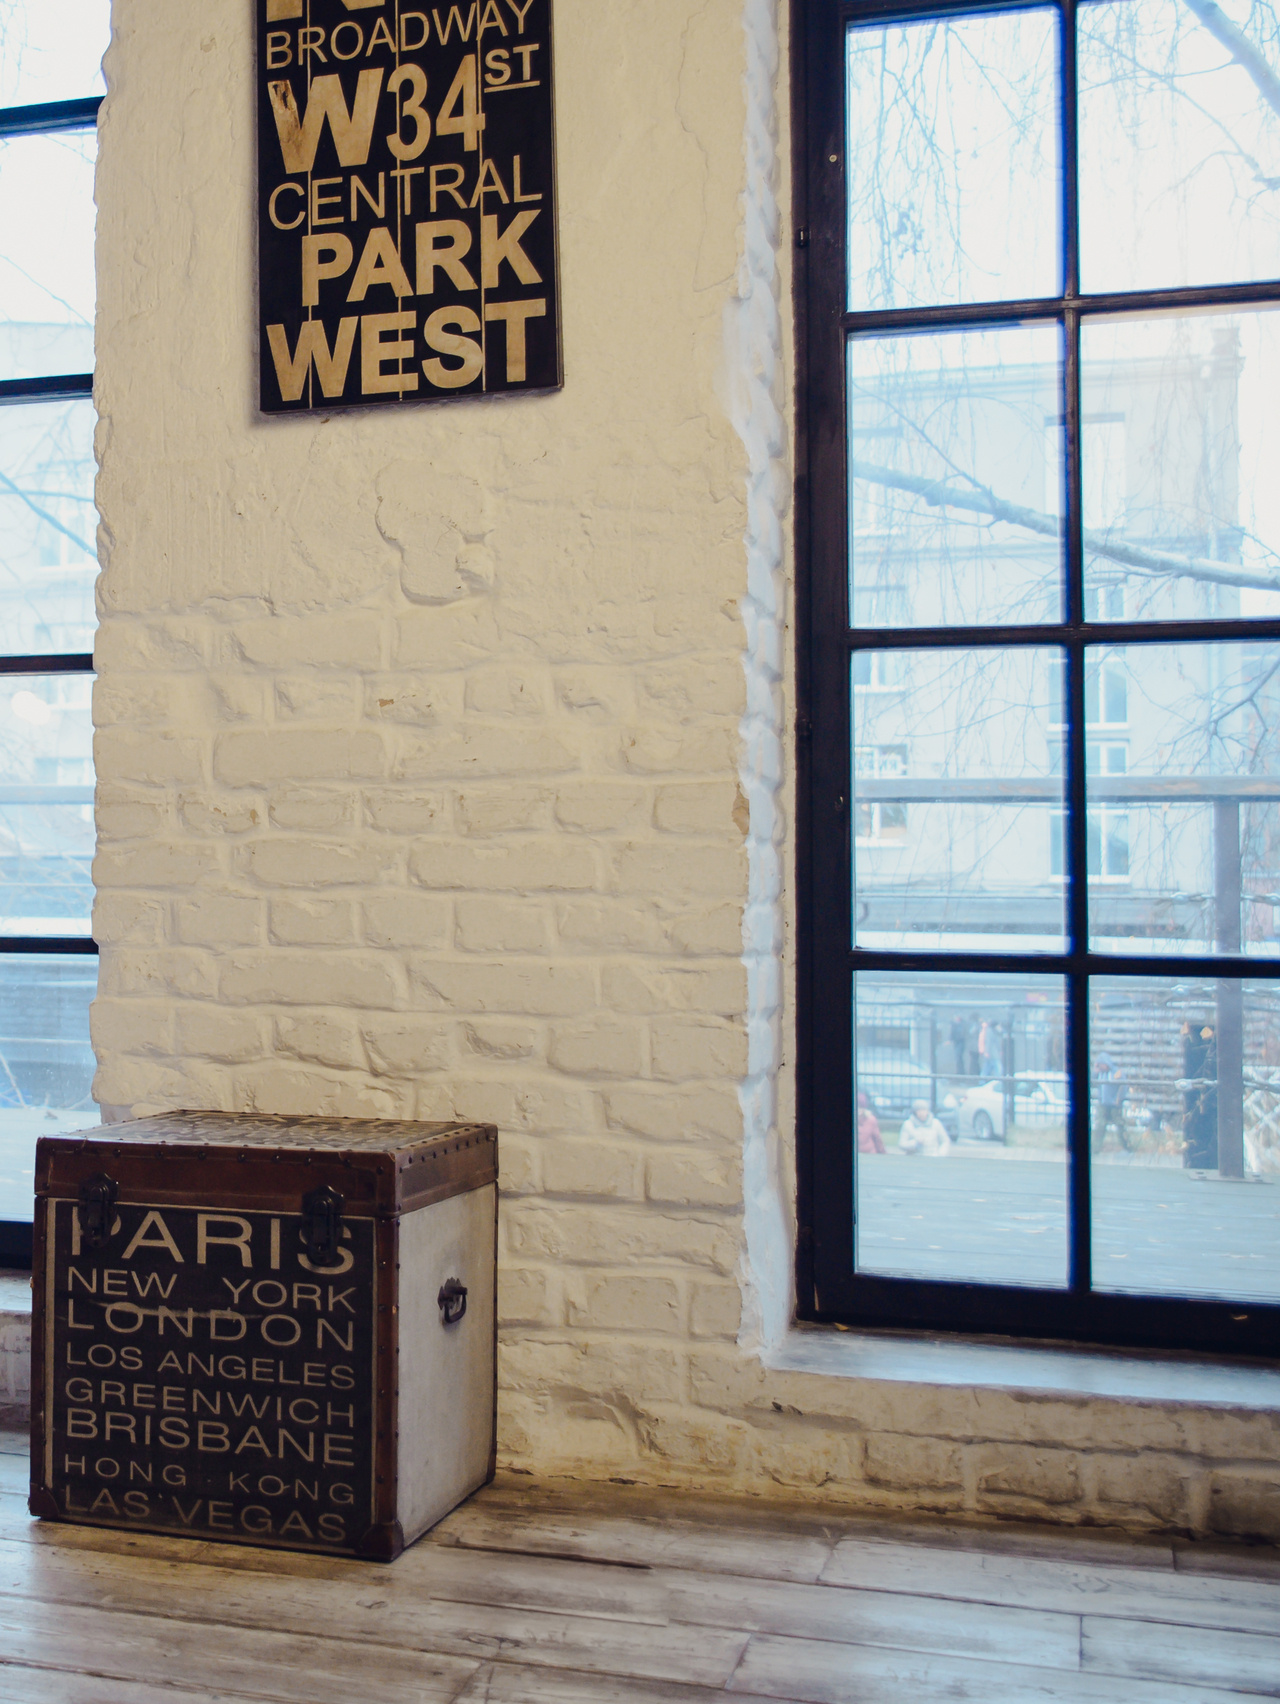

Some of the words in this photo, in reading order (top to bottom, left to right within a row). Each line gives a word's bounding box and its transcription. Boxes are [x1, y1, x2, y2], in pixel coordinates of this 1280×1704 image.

[265, 0, 531, 69] BROADWAY
[267, 54, 486, 174] W34
[484, 44, 540, 85] ST
[268, 155, 543, 230] CENTRAL
[301, 209, 543, 307] PARK
[266, 298, 546, 402] WEST
[67, 1266, 178, 1298] NEW
[222, 1277, 357, 1314] YORK
[67, 1298, 355, 1352] LONDON
[66, 1342, 143, 1370] LOS
[157, 1350, 356, 1389] ANGELES
[65, 1377, 355, 1428] GREENWICH
[66, 1408, 355, 1467] BRISBANE
[64, 1454, 187, 1486] HONG
[229, 1472, 355, 1504] KONG
[65, 1485, 151, 1518] LAS
[171, 1496, 347, 1542] VEGAS
